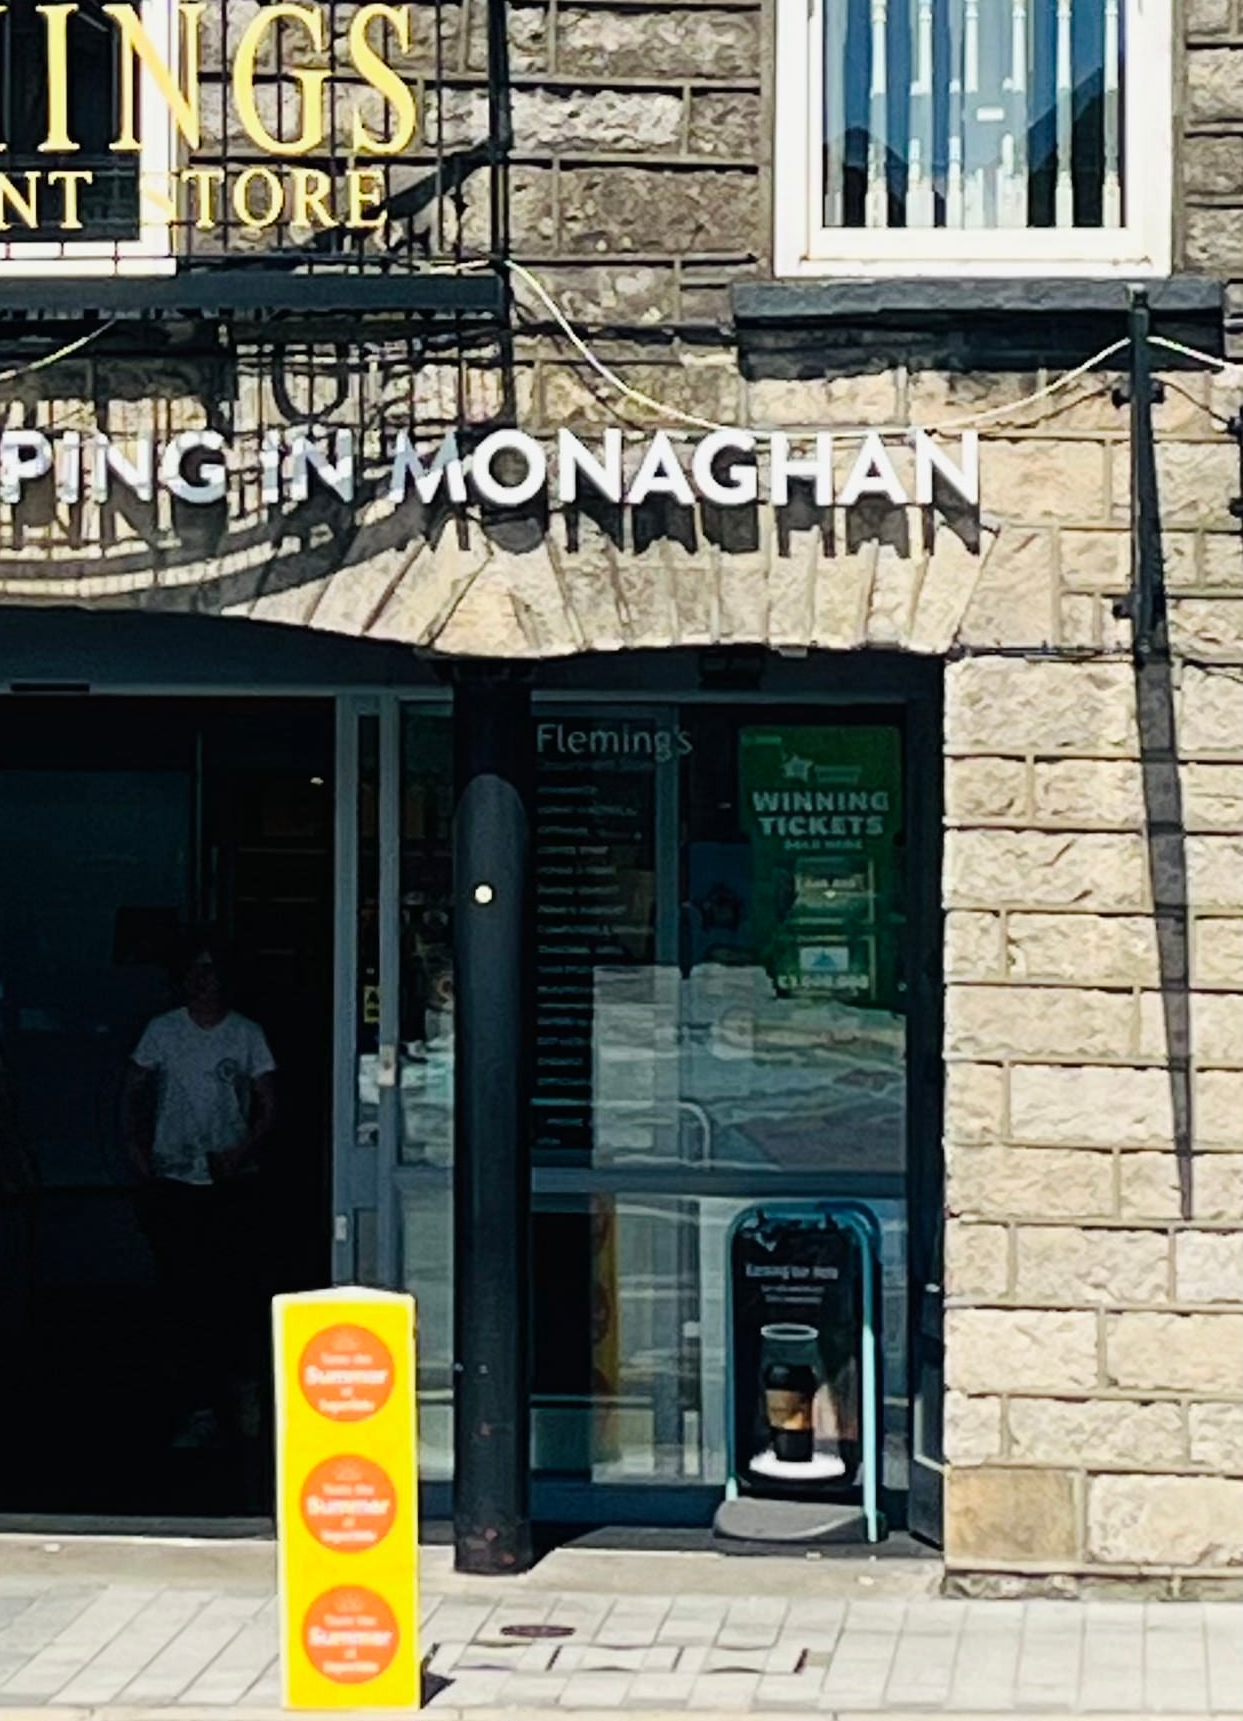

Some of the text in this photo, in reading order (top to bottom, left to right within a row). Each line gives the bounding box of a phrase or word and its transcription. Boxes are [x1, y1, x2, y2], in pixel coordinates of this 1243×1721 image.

[142, 166, 389, 230] STORE
[258, 426, 355, 505] IN
[387, 427, 980, 506] MONAGHAN
[536, 722, 693, 764] Fleming's
[751, 790, 890, 812] WINNING
[756, 815, 885, 837] TICKETS
